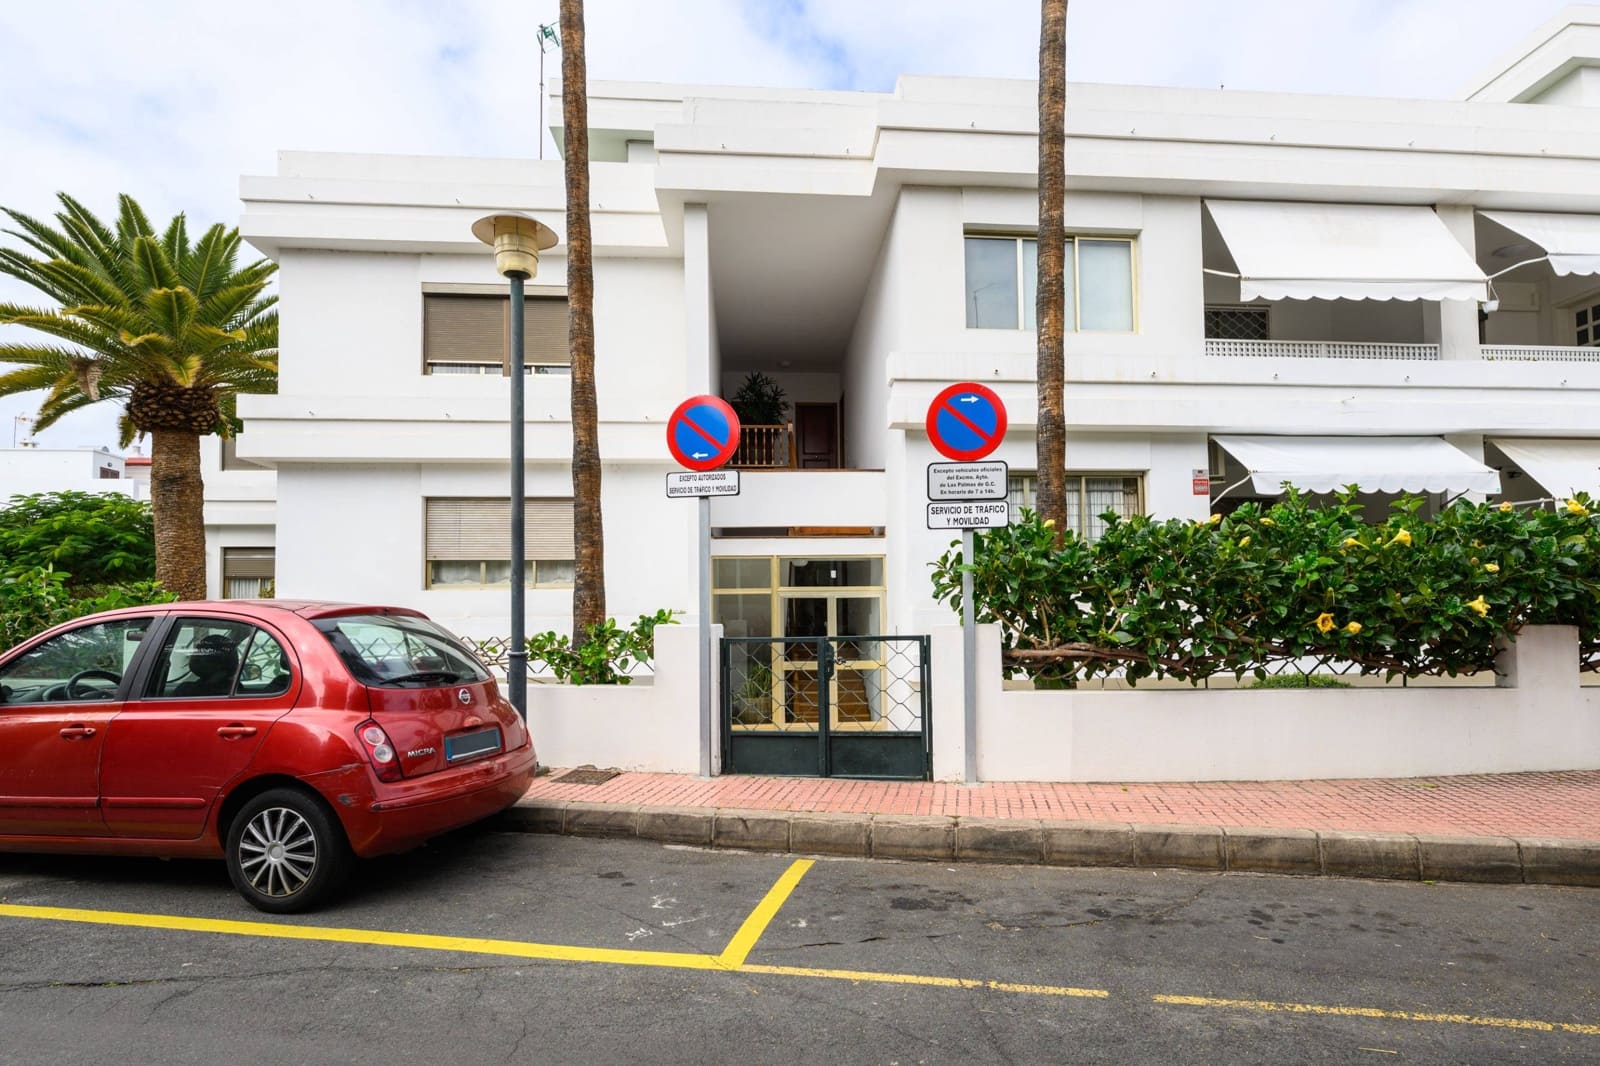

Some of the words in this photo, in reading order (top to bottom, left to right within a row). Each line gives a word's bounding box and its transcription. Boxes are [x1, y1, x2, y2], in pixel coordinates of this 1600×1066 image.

[931, 506, 961, 514] SERVICIO
[976, 505, 1005, 513] TRÁFICO
[953, 517, 989, 525] MOVILIDAD
[408, 747, 435, 757] MICRA
